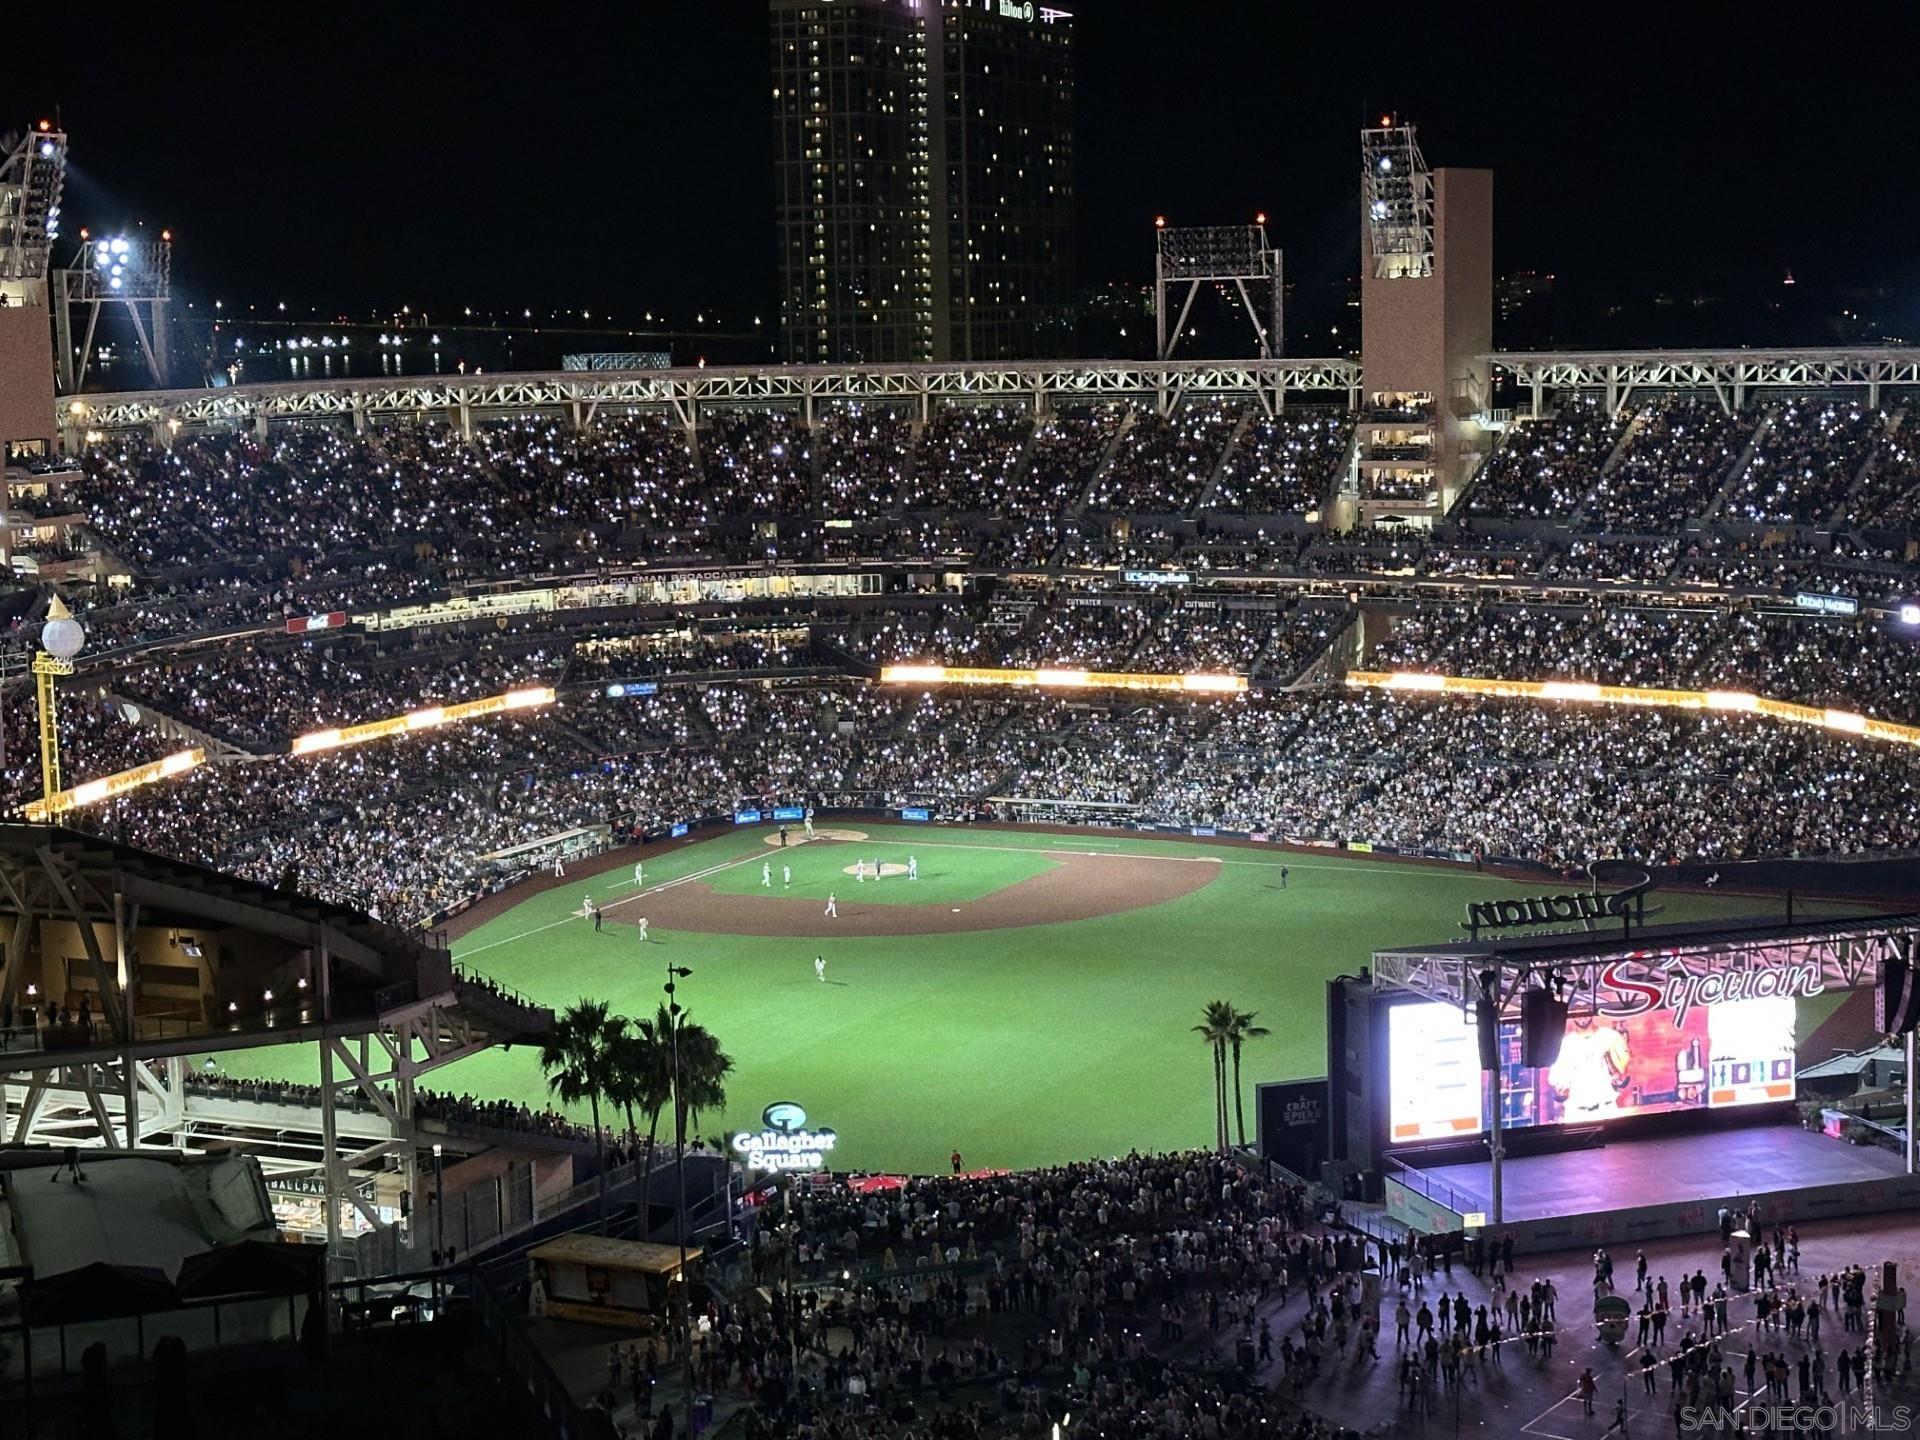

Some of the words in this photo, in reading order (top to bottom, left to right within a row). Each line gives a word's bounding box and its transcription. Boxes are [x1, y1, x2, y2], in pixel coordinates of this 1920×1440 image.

[569, 578, 605, 587] JERRY
[610, 574, 667, 584] COLEMAN
[671, 571, 745, 582] BROADCAST
[750, 568, 797, 578] CENTER
[1066, 598, 1102, 606] CUTWATER
[1184, 601, 1216, 609] CUTWATE
[1597, 946, 1825, 1029] Sycuan
[1286, 1100, 1318, 1111] CRAFT
[732, 1130, 837, 1153] Gallagher
[748, 1150, 822, 1173] Square
[271, 1178, 326, 1194] BALLPAR
